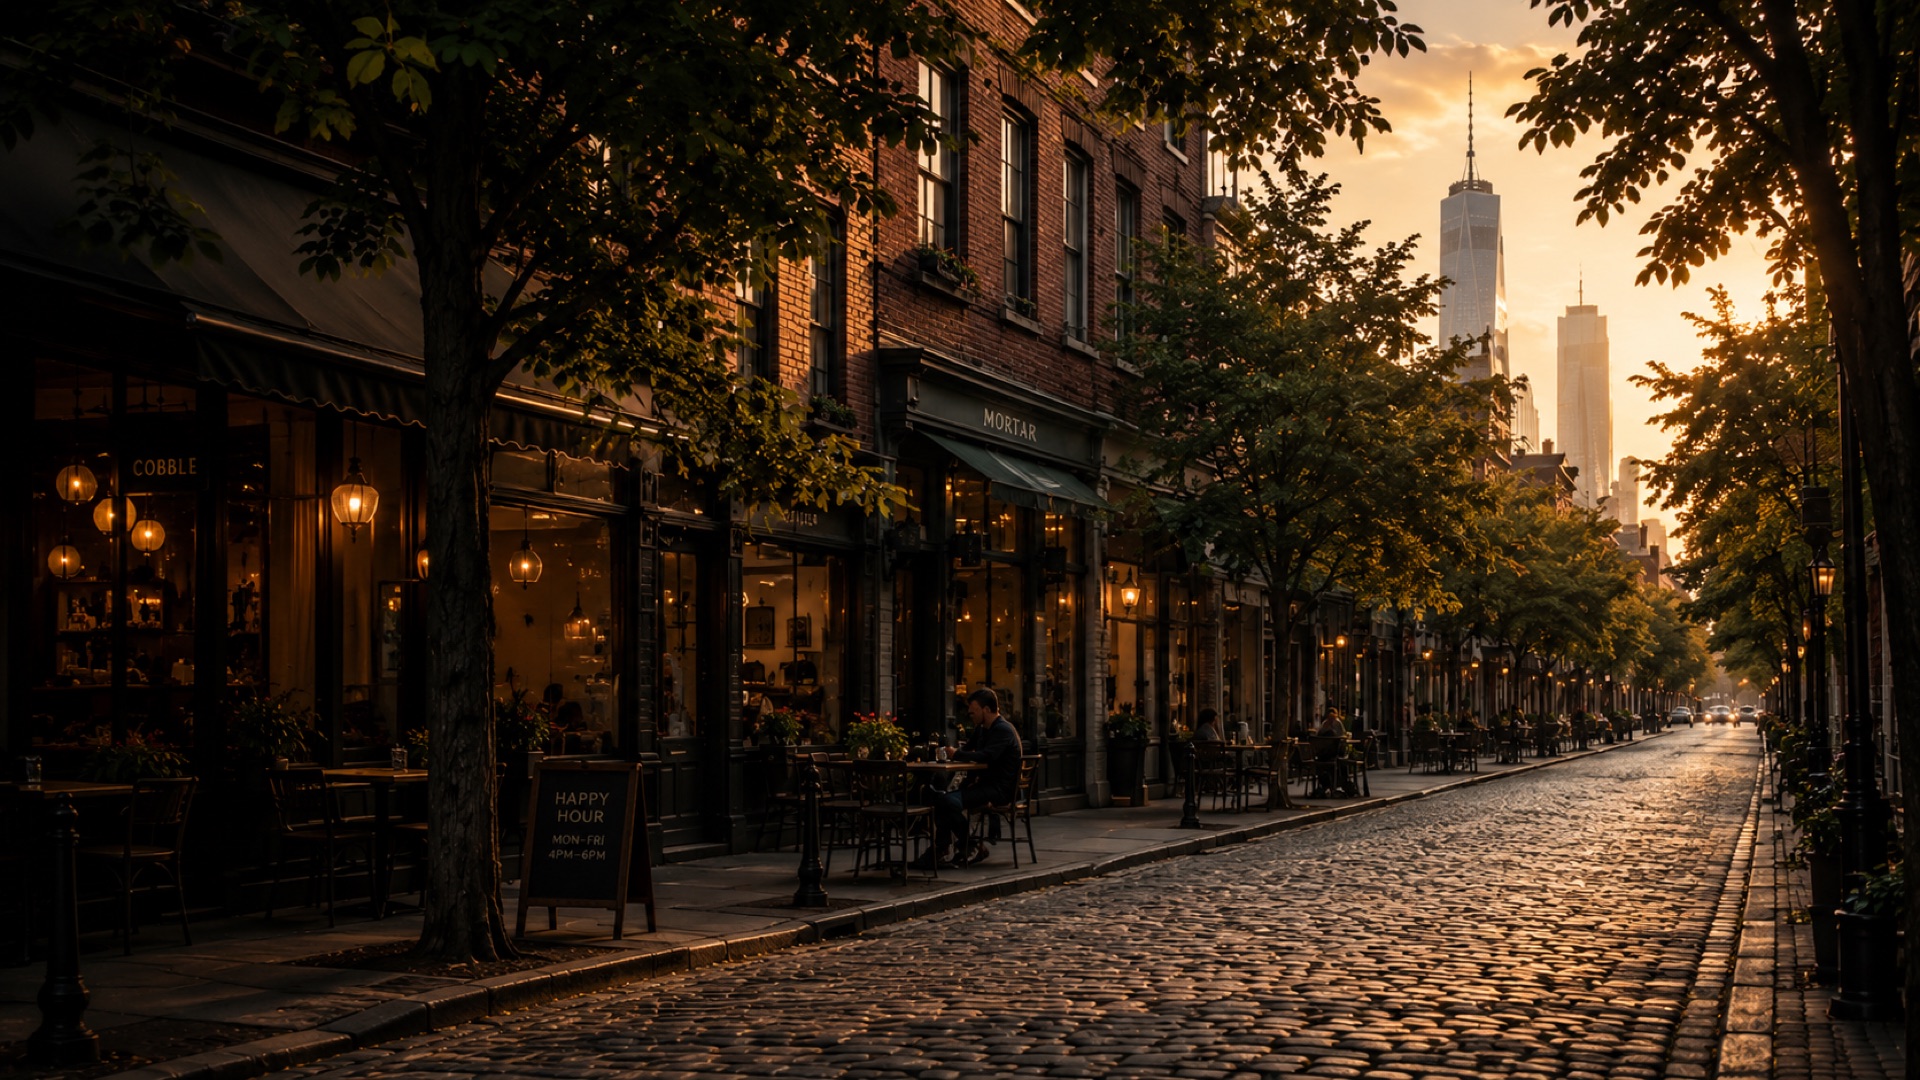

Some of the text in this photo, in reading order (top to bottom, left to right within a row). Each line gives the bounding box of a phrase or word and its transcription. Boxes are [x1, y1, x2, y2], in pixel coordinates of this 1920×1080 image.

[983, 407, 1037, 442] MORTAR
[132, 457, 197, 476] COBBLE
[555, 791, 610, 806] HAPPY
[557, 809, 605, 823] HOUR
